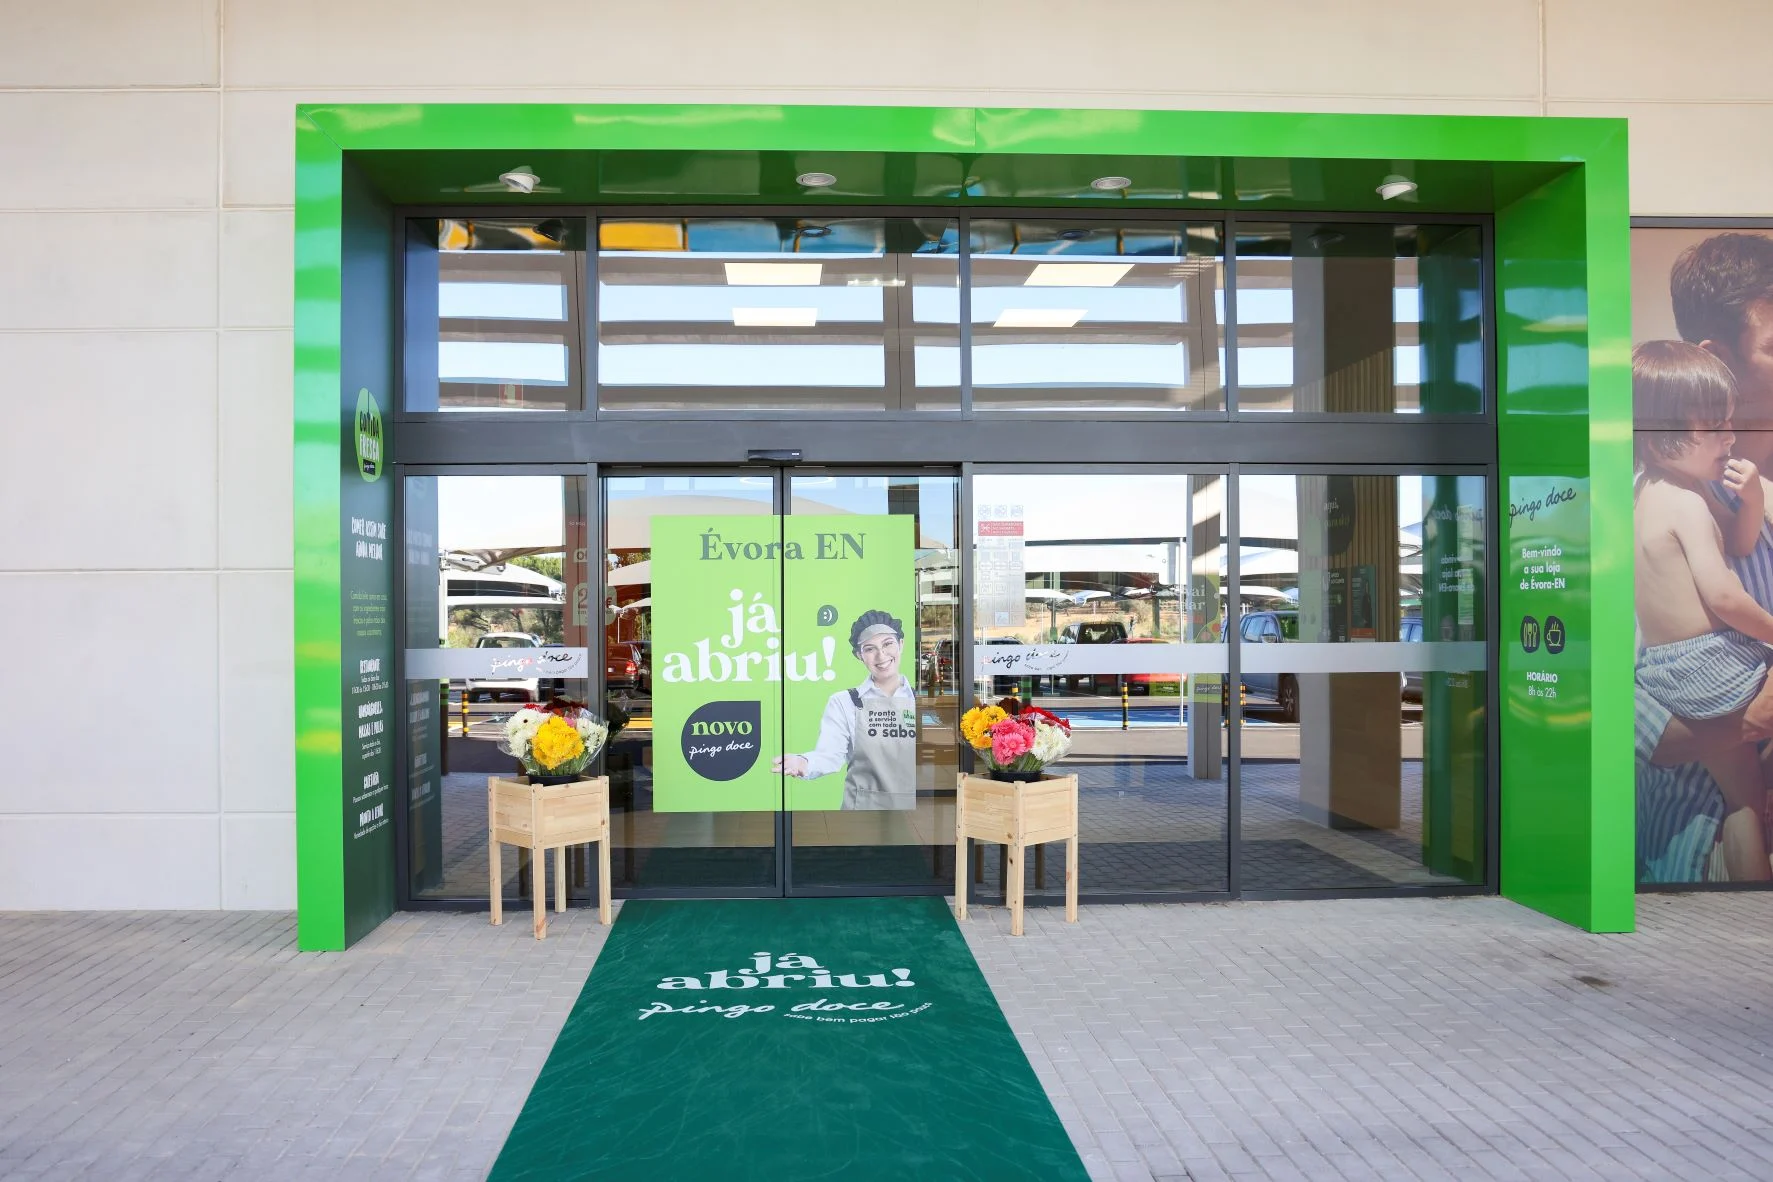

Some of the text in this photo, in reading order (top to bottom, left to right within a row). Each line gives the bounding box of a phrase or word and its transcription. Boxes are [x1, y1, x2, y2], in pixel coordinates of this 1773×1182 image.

[1509, 486, 1577, 528] pingo doce
[699, 527, 867, 561] Évora EN
[1521, 545, 1561, 559] Bem-vindo
[1530, 565, 1544, 574] sua
[1545, 562, 1561, 576] loja
[1519, 576, 1566, 590] de Évora-EN
[721, 588, 782, 649] já
[662, 636, 836, 683] abriu!
[1526, 670, 1558, 683] HORÁRIO
[1528, 685, 1536, 696] 8h
[1544, 687, 1557, 698] 22h
[691, 720, 753, 736] novo
[868, 728, 877, 737] o
[689, 741, 754, 760] pingo doce
[738, 951, 825, 975] já
[656, 968, 915, 990] abriu!
[638, 998, 905, 1021] pingo doce
[849, 1016, 888, 1024] pagar
